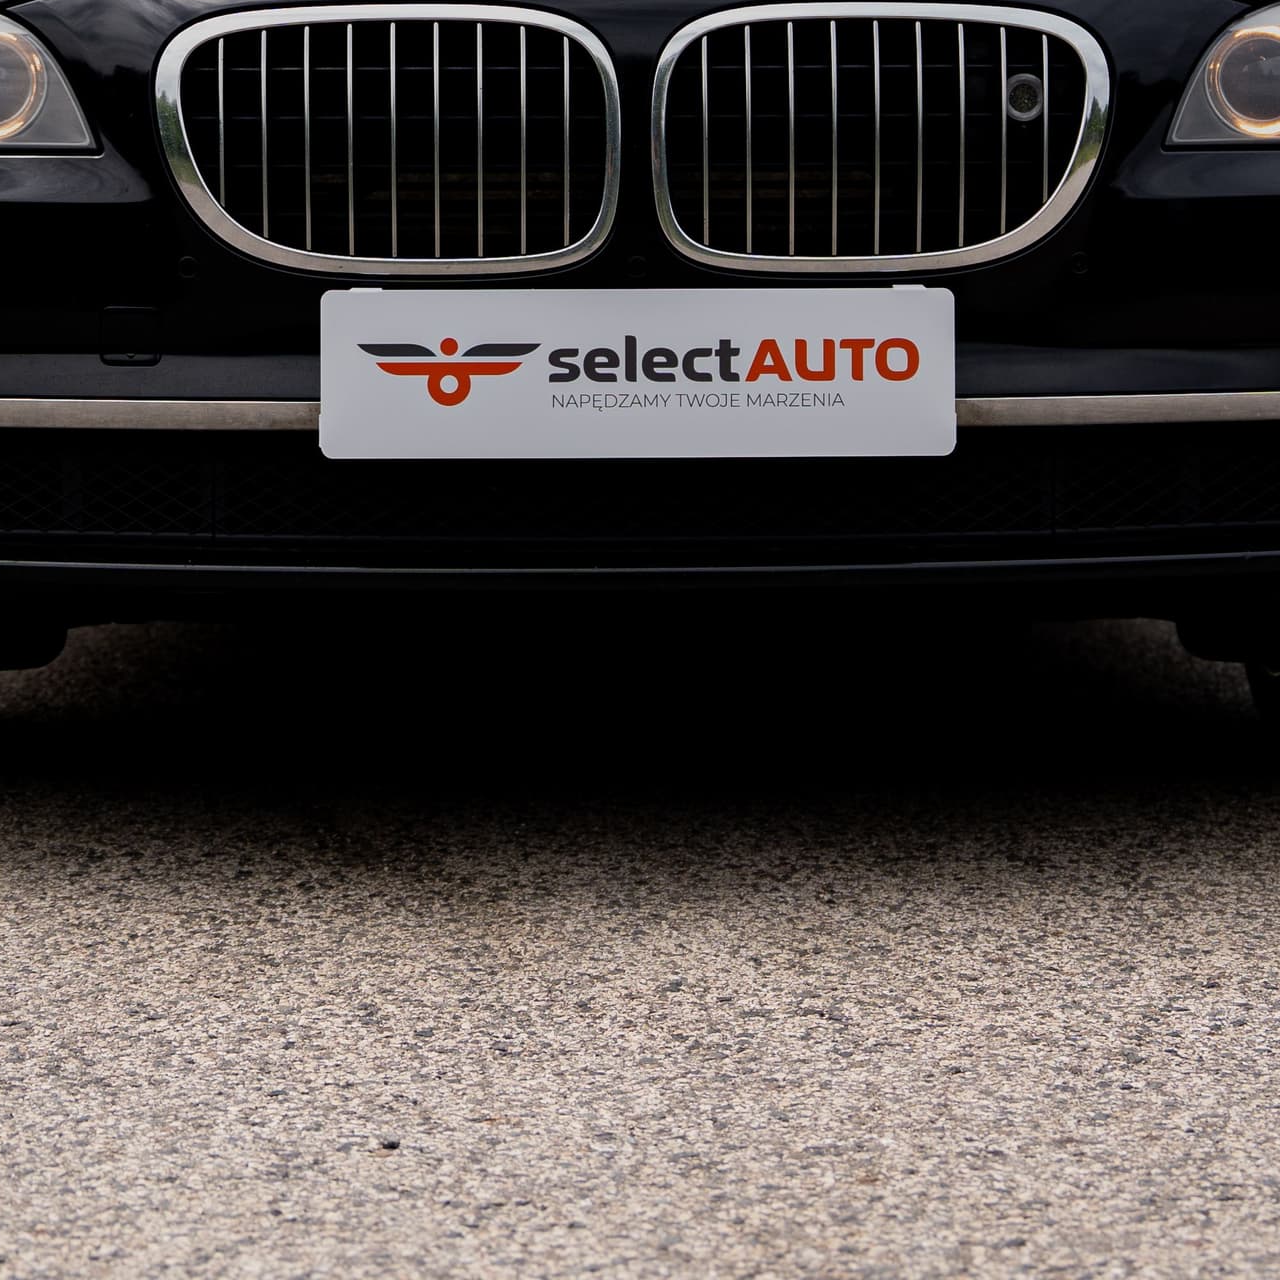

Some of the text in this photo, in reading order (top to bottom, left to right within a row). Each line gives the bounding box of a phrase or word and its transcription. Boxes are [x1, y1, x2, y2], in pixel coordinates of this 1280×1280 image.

[548, 335, 920, 382] selectAUTO
[551, 392, 845, 412] NAPĘDZAMY TWOJE MARZENIA
